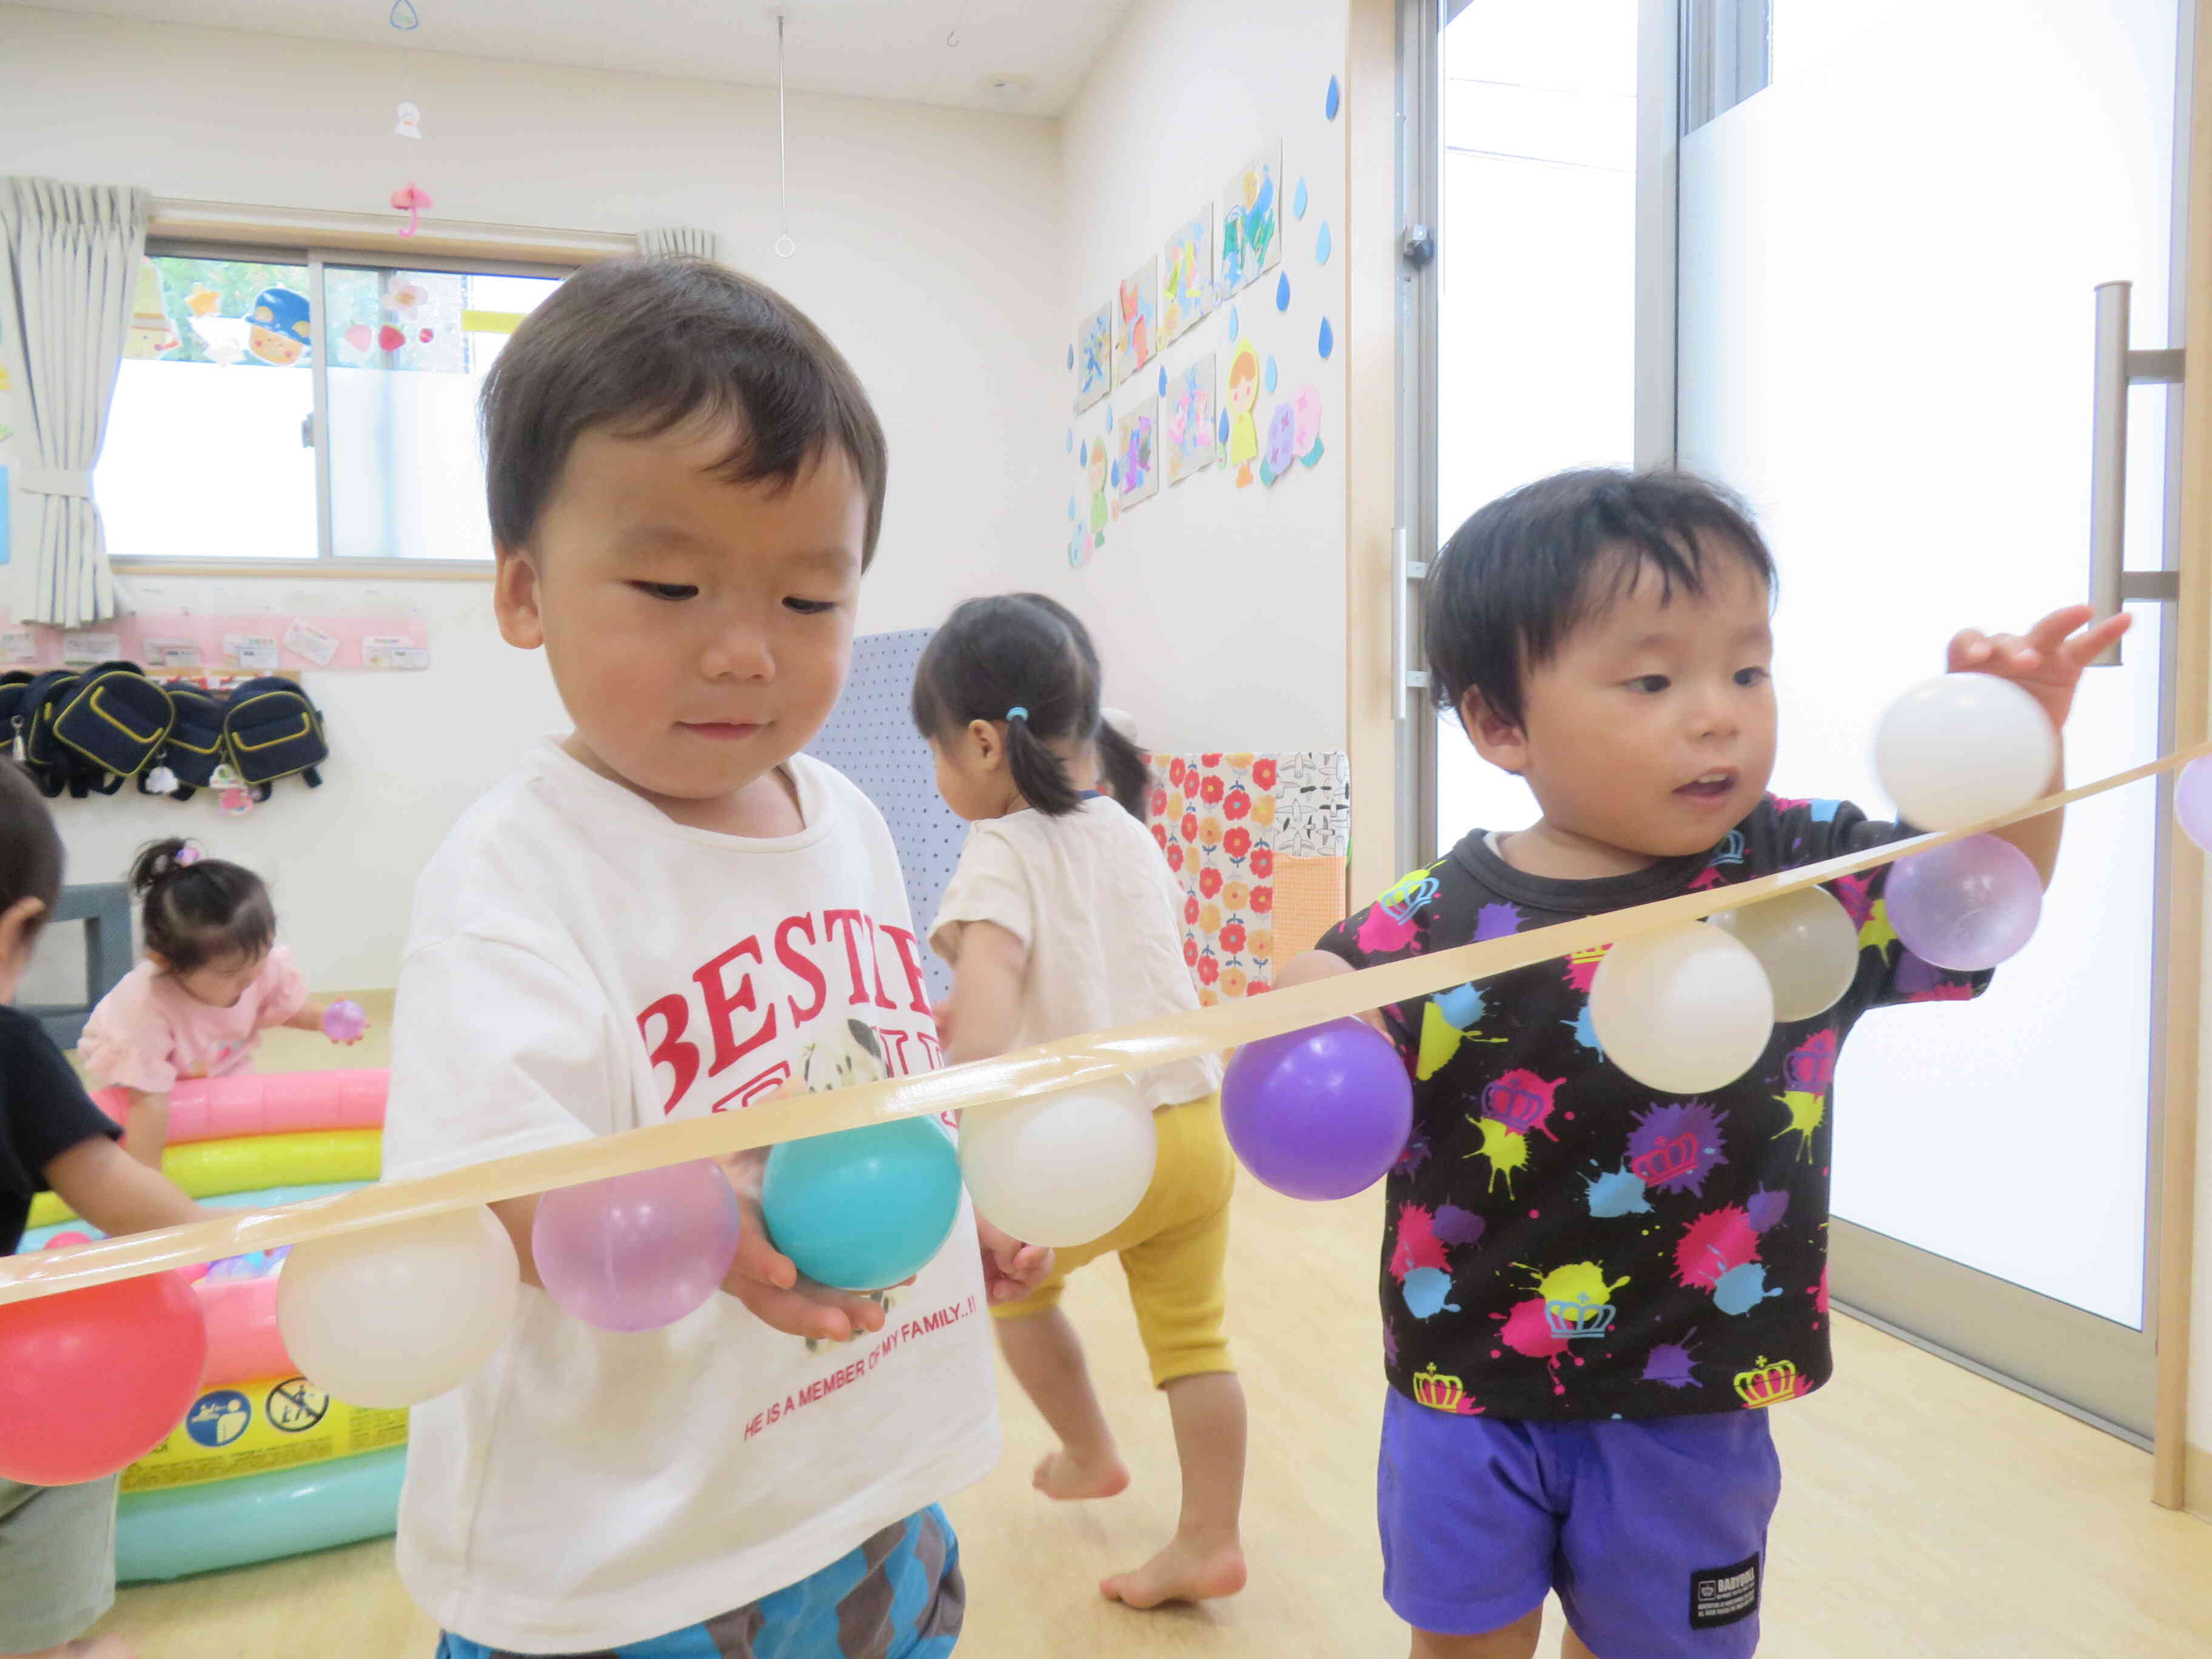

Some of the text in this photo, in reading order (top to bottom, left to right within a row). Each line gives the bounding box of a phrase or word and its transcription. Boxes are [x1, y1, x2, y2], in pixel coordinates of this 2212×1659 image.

[744, 1413, 763, 1441] HE
[766, 1403, 780, 1425] IS
[784, 1395, 795, 1415] A
[799, 1359, 865, 1407] MEMBER
[882, 1330, 898, 1356] MY
